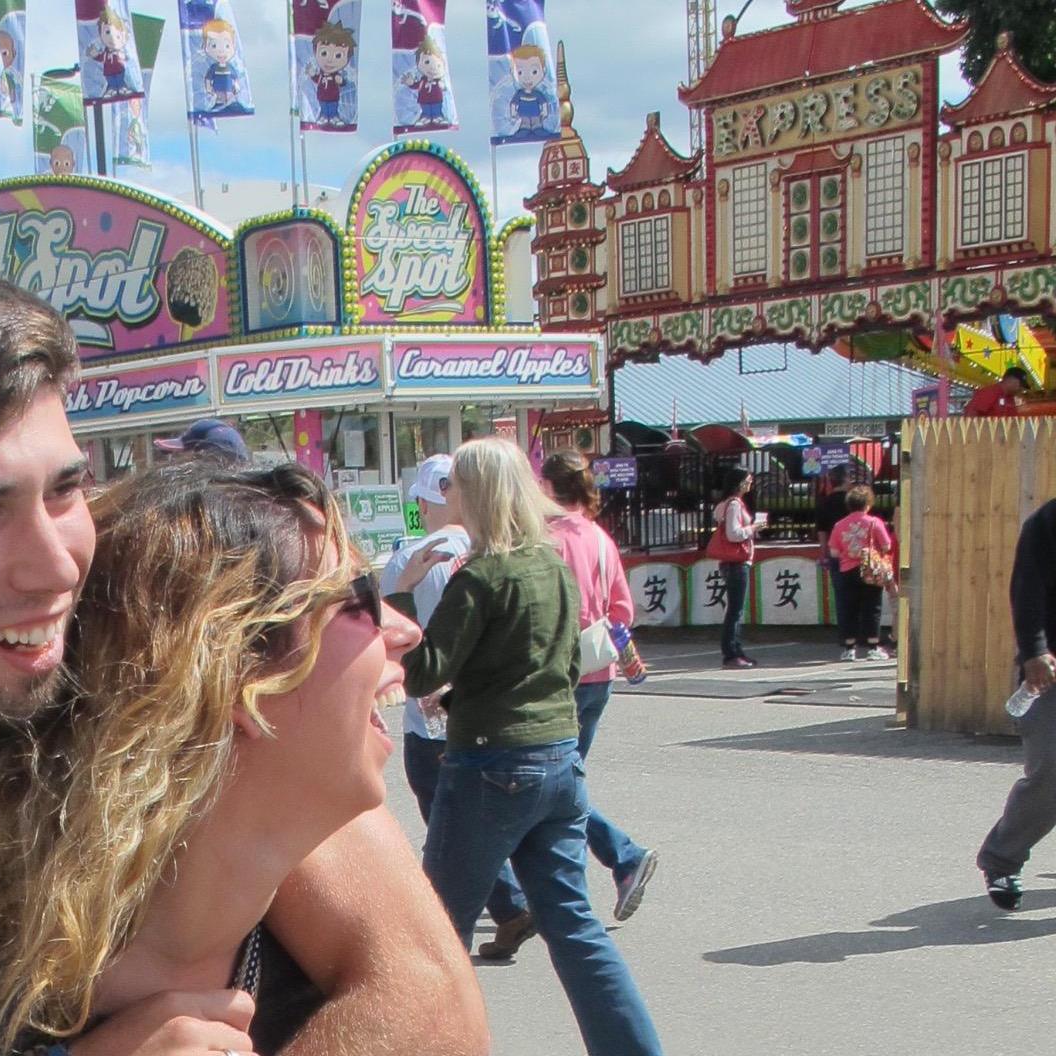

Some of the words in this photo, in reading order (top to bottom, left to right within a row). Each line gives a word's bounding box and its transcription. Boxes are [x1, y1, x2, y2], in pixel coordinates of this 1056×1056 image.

[713, 70, 919, 157] EXPRESS
[403, 184, 441, 216] The
[365, 200, 468, 252] Sweet
[17, 210, 165, 323] Spot
[361, 230, 472, 312] Spot
[225, 354, 285, 396] Cold
[284, 351, 377, 391] Drinks
[398, 347, 507, 379] Caramel
[505, 346, 590, 385] Apples
[96, 376, 204, 412] Popcorn
[773, 569, 802, 610] 安
